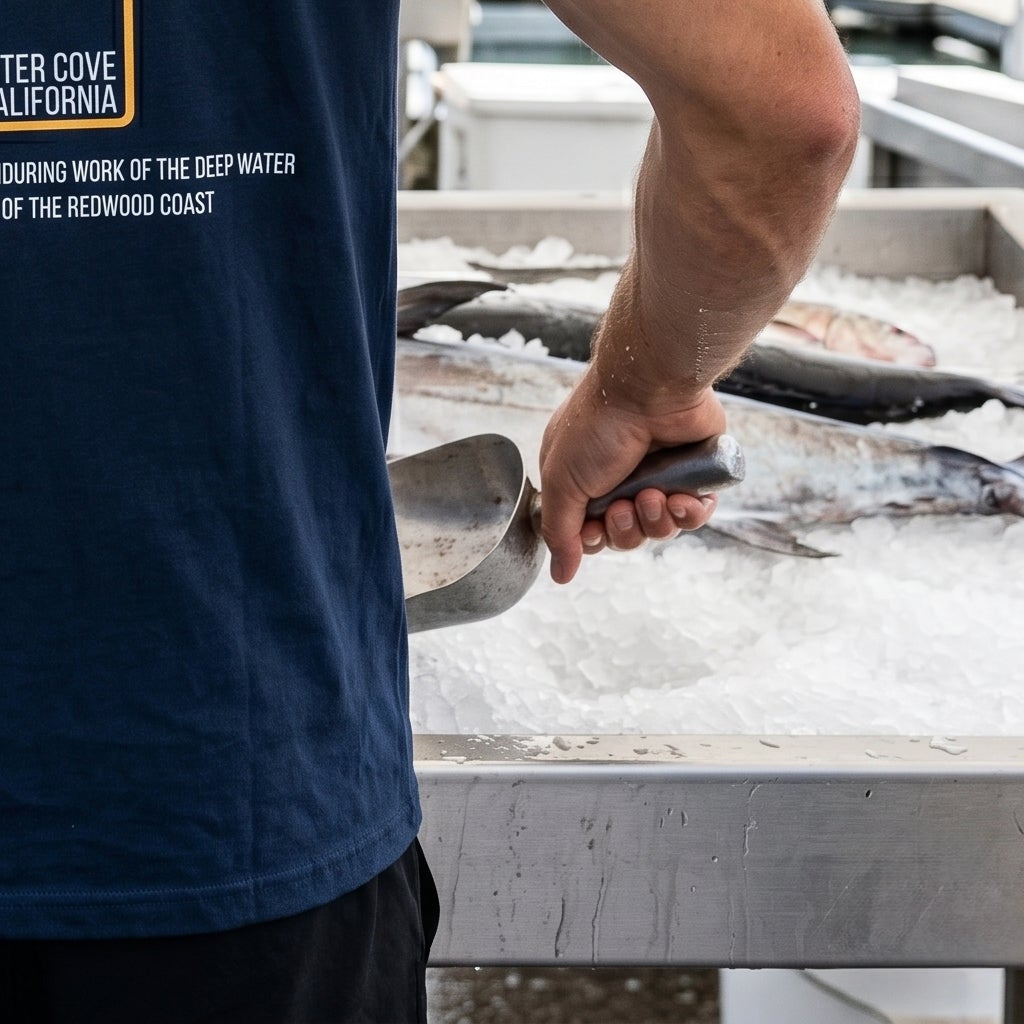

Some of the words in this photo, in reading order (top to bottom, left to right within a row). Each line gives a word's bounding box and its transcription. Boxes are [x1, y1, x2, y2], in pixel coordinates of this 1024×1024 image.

[53, 51, 117, 83] COVE
[71, 159, 125, 183] WORK
[130, 157, 152, 181] OF
[156, 156, 190, 180] THE
[195, 153, 234, 179] DEEP
[236, 152, 296, 175] WATER
[1, 196, 24, 220] OF
[28, 195, 63, 219] THE
[67, 193, 155, 218] REDWOOD
[160, 190, 215, 216] COAST
